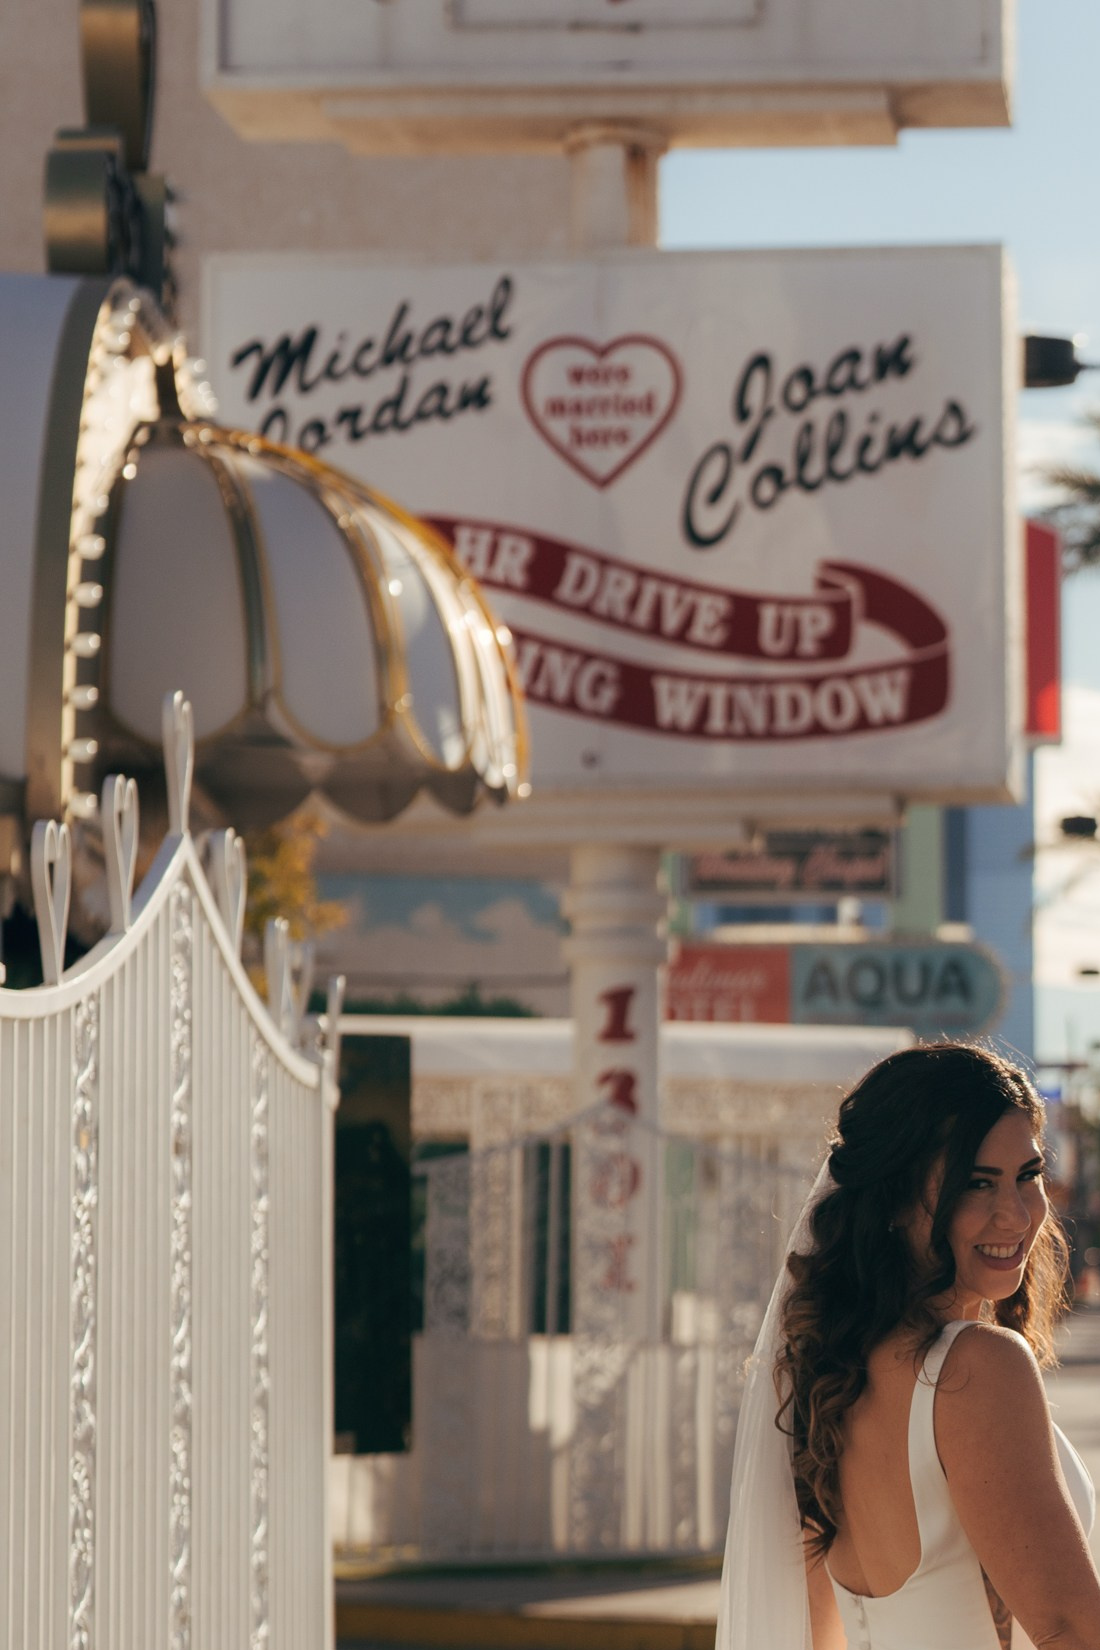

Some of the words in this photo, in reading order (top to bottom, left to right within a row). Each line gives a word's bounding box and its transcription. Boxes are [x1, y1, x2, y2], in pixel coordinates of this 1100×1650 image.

[230, 274, 514, 402] Michael
[733, 334, 914, 464] Joan
[680, 396, 976, 549] Collins
[453, 524, 535, 588] HR
[552, 551, 734, 650] DRIVE
[757, 602, 836, 658] UP
[517, 640, 623, 716] ING
[650, 668, 913, 736] WINDOW
[802, 955, 975, 1008] AQUA
